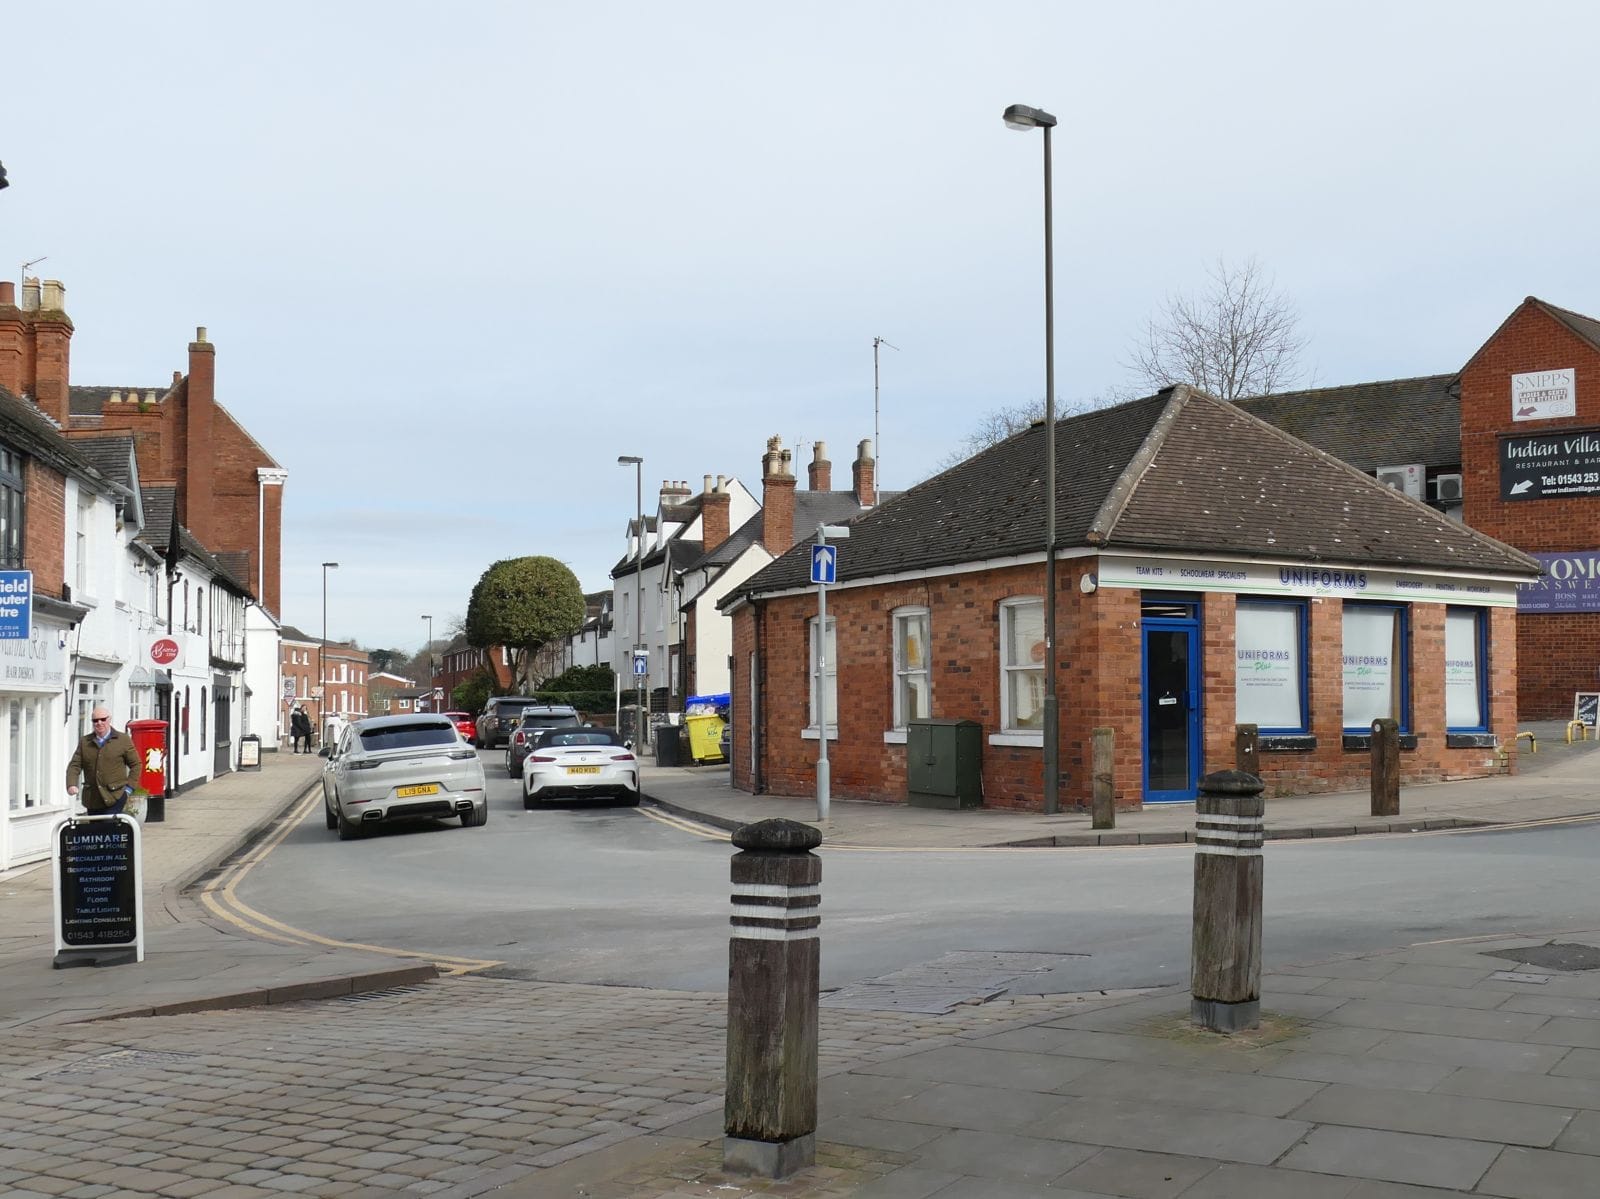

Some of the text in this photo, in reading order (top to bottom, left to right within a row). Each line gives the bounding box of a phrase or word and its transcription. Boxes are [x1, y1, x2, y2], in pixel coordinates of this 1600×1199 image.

[1516, 374, 1570, 389] SNIPPS
[1508, 436, 1600, 458] Indian Villa
[1516, 459, 1570, 469] RESTAURANT
[1541, 472, 1599, 485] Tel: 01543 253
[1136, 566, 1163, 576] TEAM KITS
[1180, 568, 1246, 579] SCHOOLWEAR SPECIALISTS
[1537, 558, 1600, 580] UOM
[1279, 569, 1367, 588] UNIFORMS
[0, 579, 27, 592] ield
[1396, 580, 1423, 589] EMBROIDERY
[1435, 583, 1455, 591] PRINTING
[1238, 650, 1289, 660] UNIFORMS
[1343, 656, 1388, 666] UNIFORMS
[65, 834, 128, 844] LUMINARE
[67, 931, 94, 939] 01543
